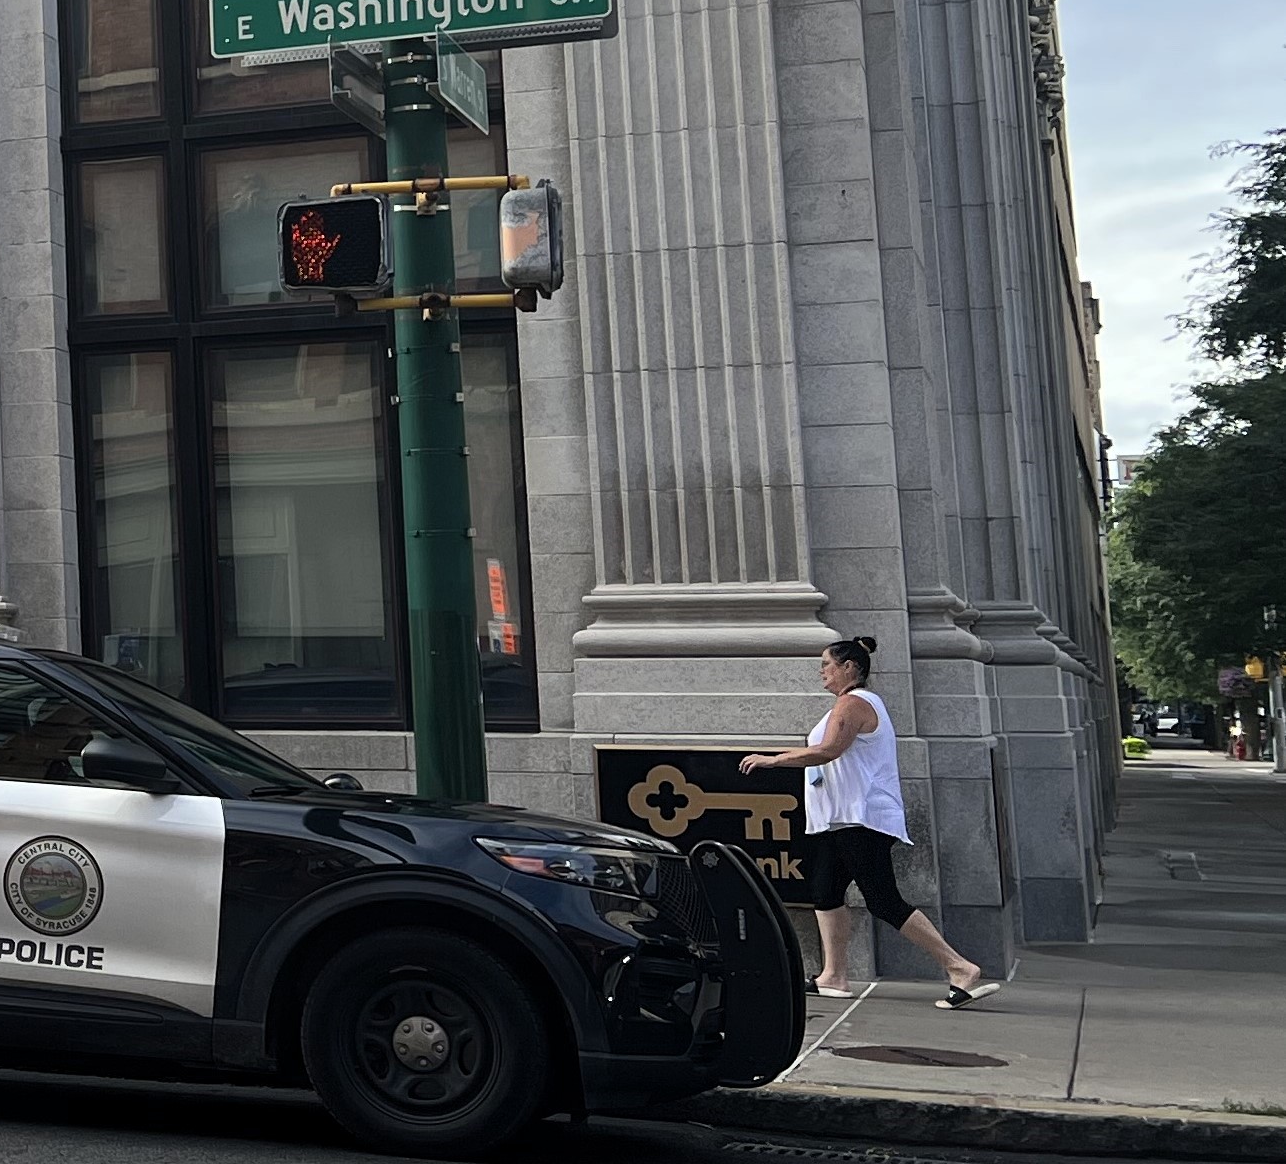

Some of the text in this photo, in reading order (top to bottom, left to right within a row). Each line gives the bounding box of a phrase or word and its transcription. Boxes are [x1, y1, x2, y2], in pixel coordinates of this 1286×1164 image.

[237, 16, 255, 40] E
[18, 842, 90, 868] CENTRAL CITY
[10, 882, 24, 905] CITY
[20, 907, 34, 920] OF
[35, 909, 88, 930] SYRACUSE
